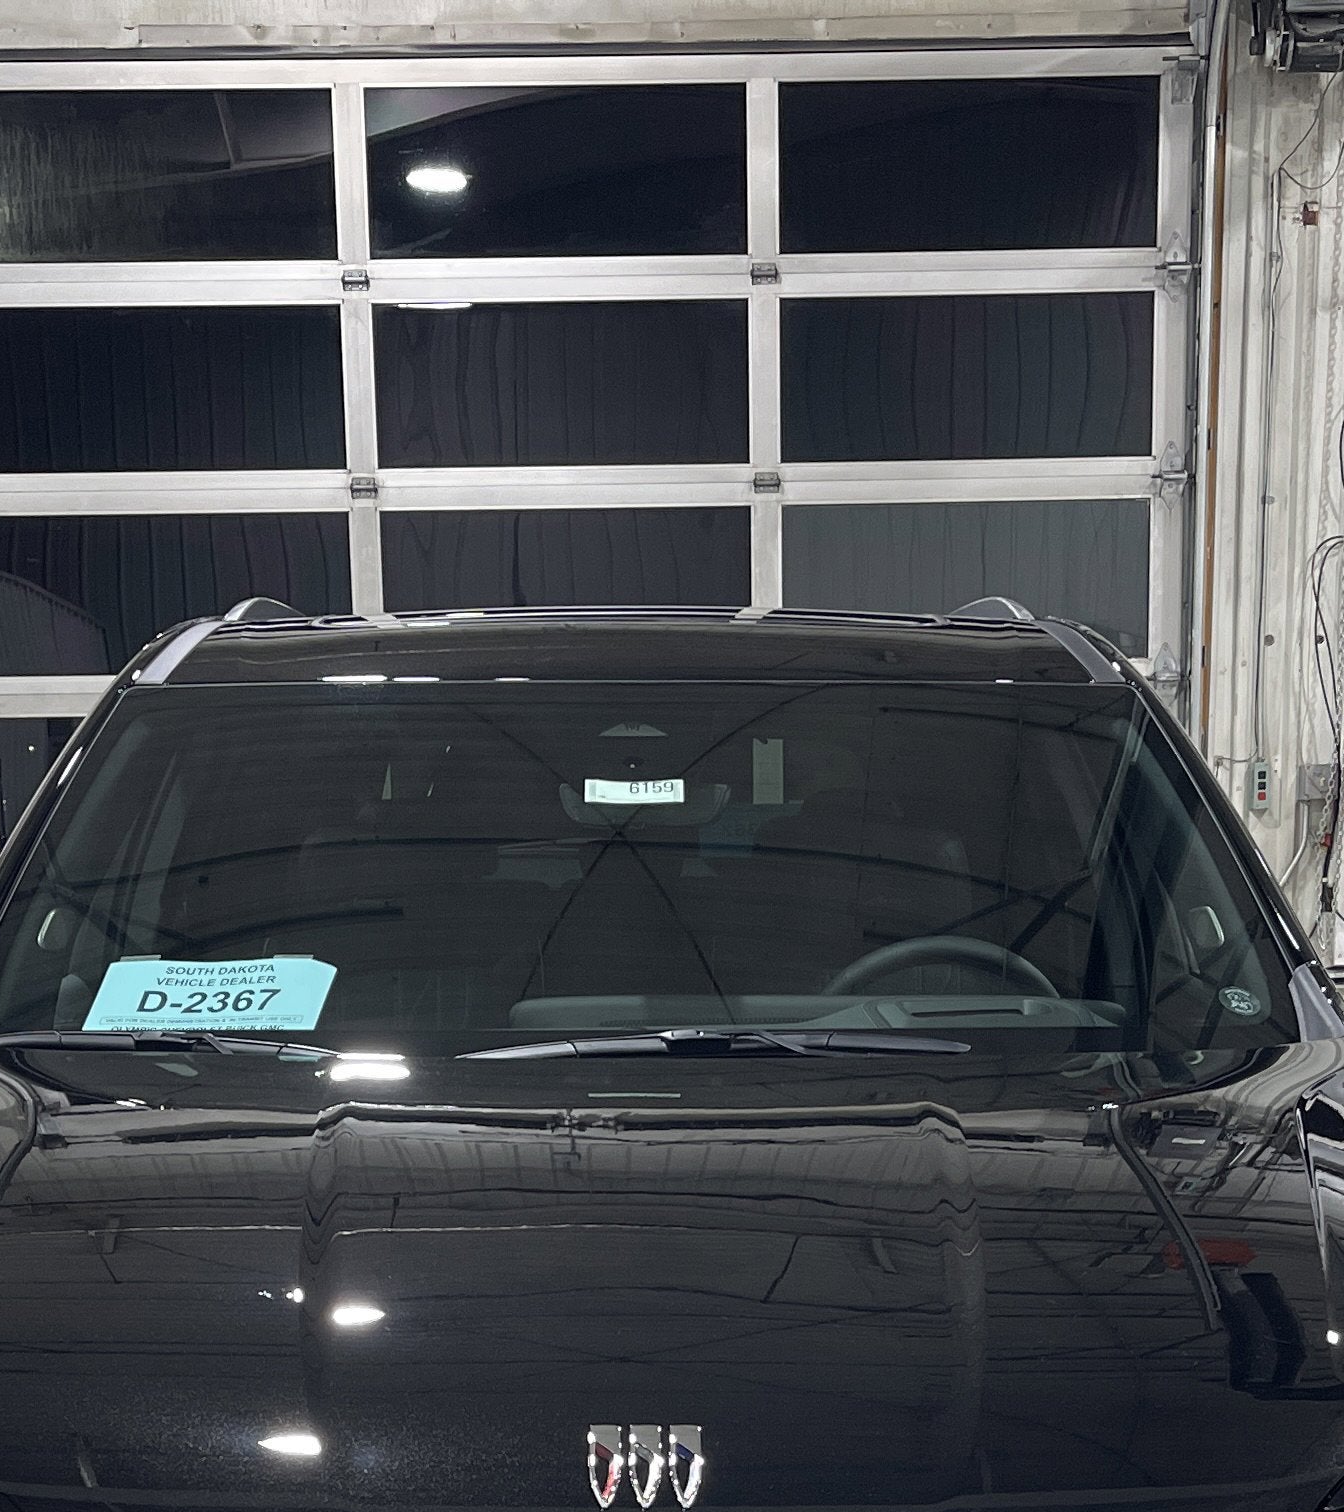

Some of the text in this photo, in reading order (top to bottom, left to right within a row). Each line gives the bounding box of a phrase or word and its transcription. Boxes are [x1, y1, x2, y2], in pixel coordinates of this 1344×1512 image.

[629, 781, 674, 794] 6159
[165, 963, 275, 976] SOUTH DAKOTA
[156, 975, 277, 987] VEHICLE DEALER
[136, 988, 282, 1014] D-2367
